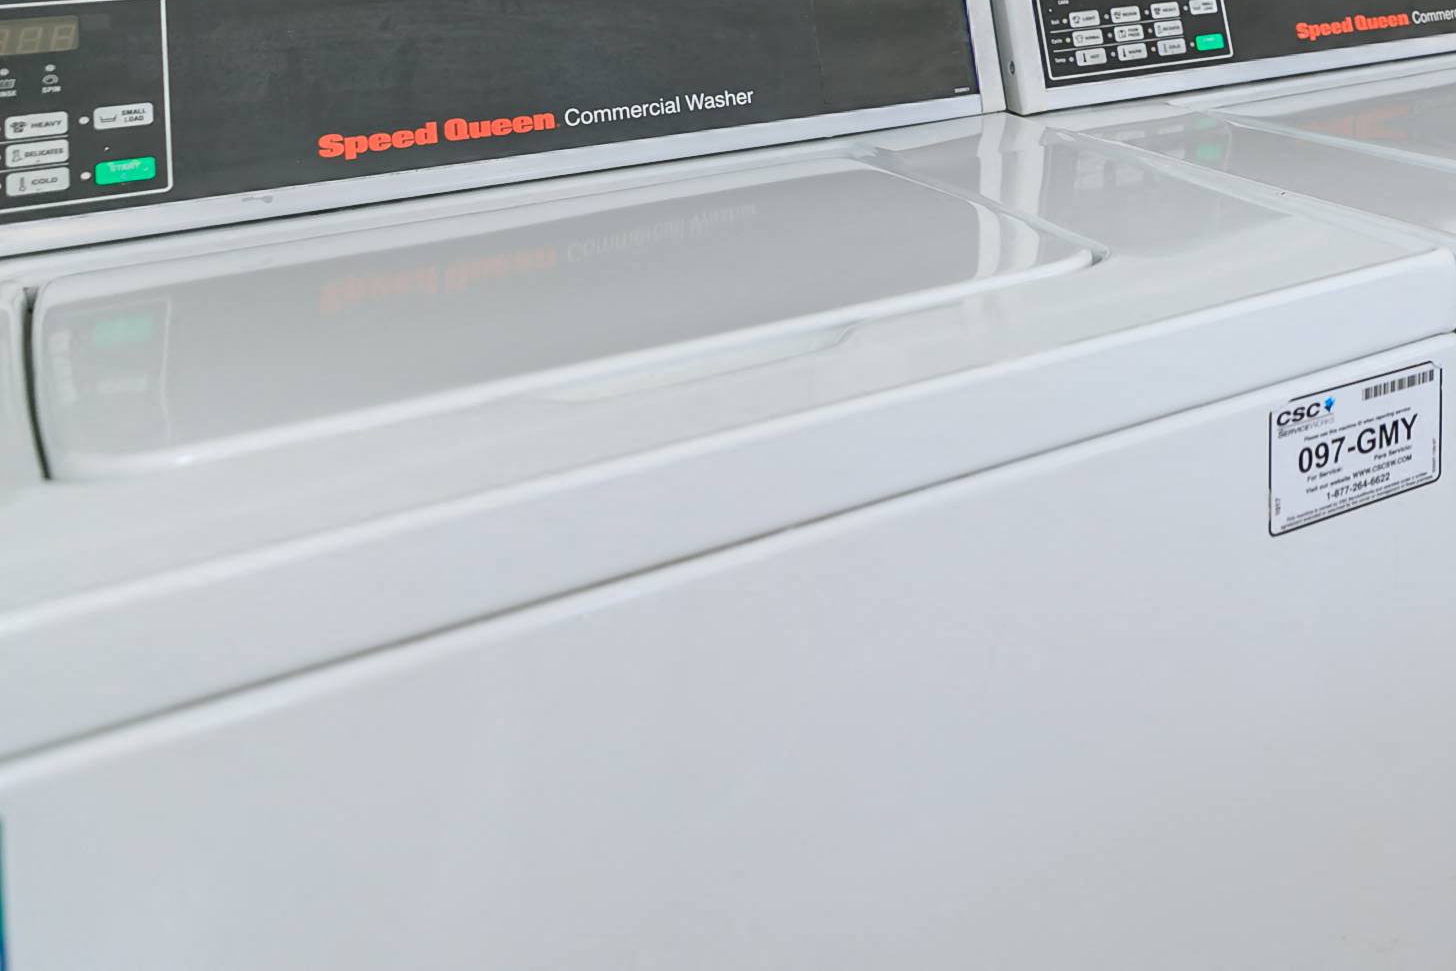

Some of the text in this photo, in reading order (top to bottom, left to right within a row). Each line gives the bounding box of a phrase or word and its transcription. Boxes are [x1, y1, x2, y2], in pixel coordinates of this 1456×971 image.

[1295, 16, 1353, 42] Speed
[1354, 11, 1410, 31] Queen
[121, 108, 146, 116] SMALL
[124, 115, 144, 123] LOAD
[30, 120, 62, 128] HEAVY
[317, 88, 755, 160] Speed Queen Commercial Washer
[24, 148, 64, 158] DELICATES
[31, 177, 58, 185] COLD
[1276, 402, 1321, 427] CSC
[1299, 413, 1418, 474] 097-GMY
[1319, 468, 1342, 477] Service:
[1306, 486, 1318, 494] Visit
